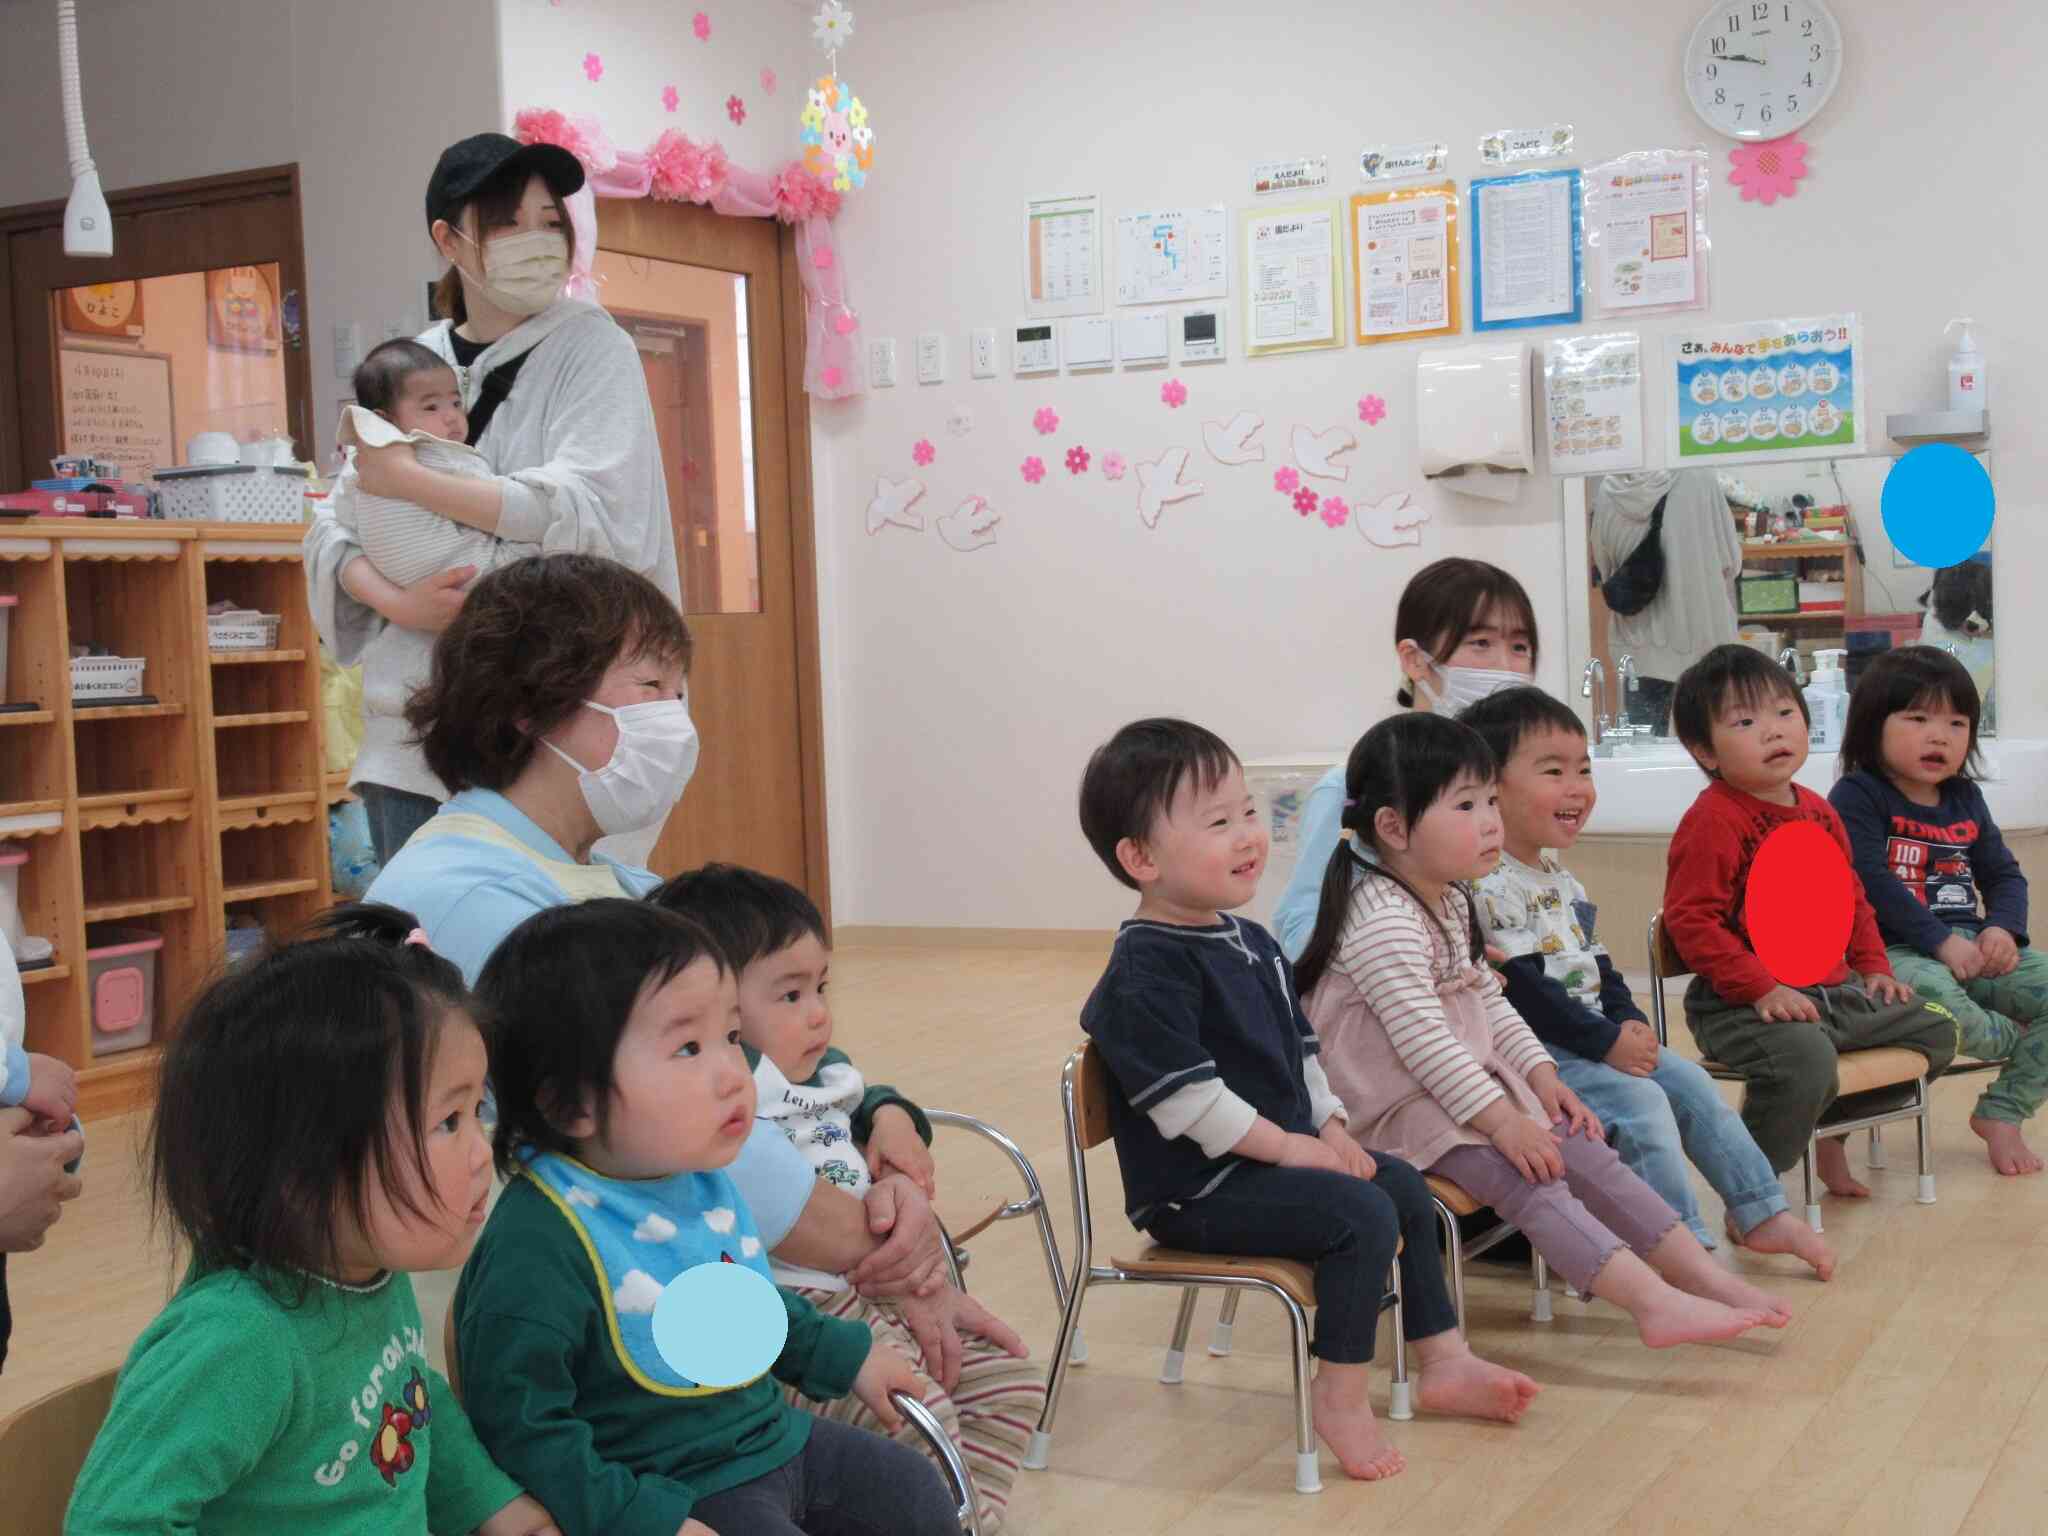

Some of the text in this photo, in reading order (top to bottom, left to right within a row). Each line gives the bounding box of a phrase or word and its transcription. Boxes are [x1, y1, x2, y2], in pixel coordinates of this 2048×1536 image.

[1752, 2, 1768, 20] 12
[1784, 4, 1789, 22] 1
[1729, 15, 1740, 33] 11
[1801, 19, 1813, 37] 2
[1711, 36, 1726, 54] 10
[1809, 44, 1821, 62] 3
[1706, 63, 1717, 80] 9
[1801, 72, 1812, 88] 4
[1714, 88, 1726, 105] 8
[1786, 94, 1798, 112] 5
[1734, 103, 1745, 121] 7
[1760, 105, 1772, 122] 6
[314, 1440, 359, 1487] Go
